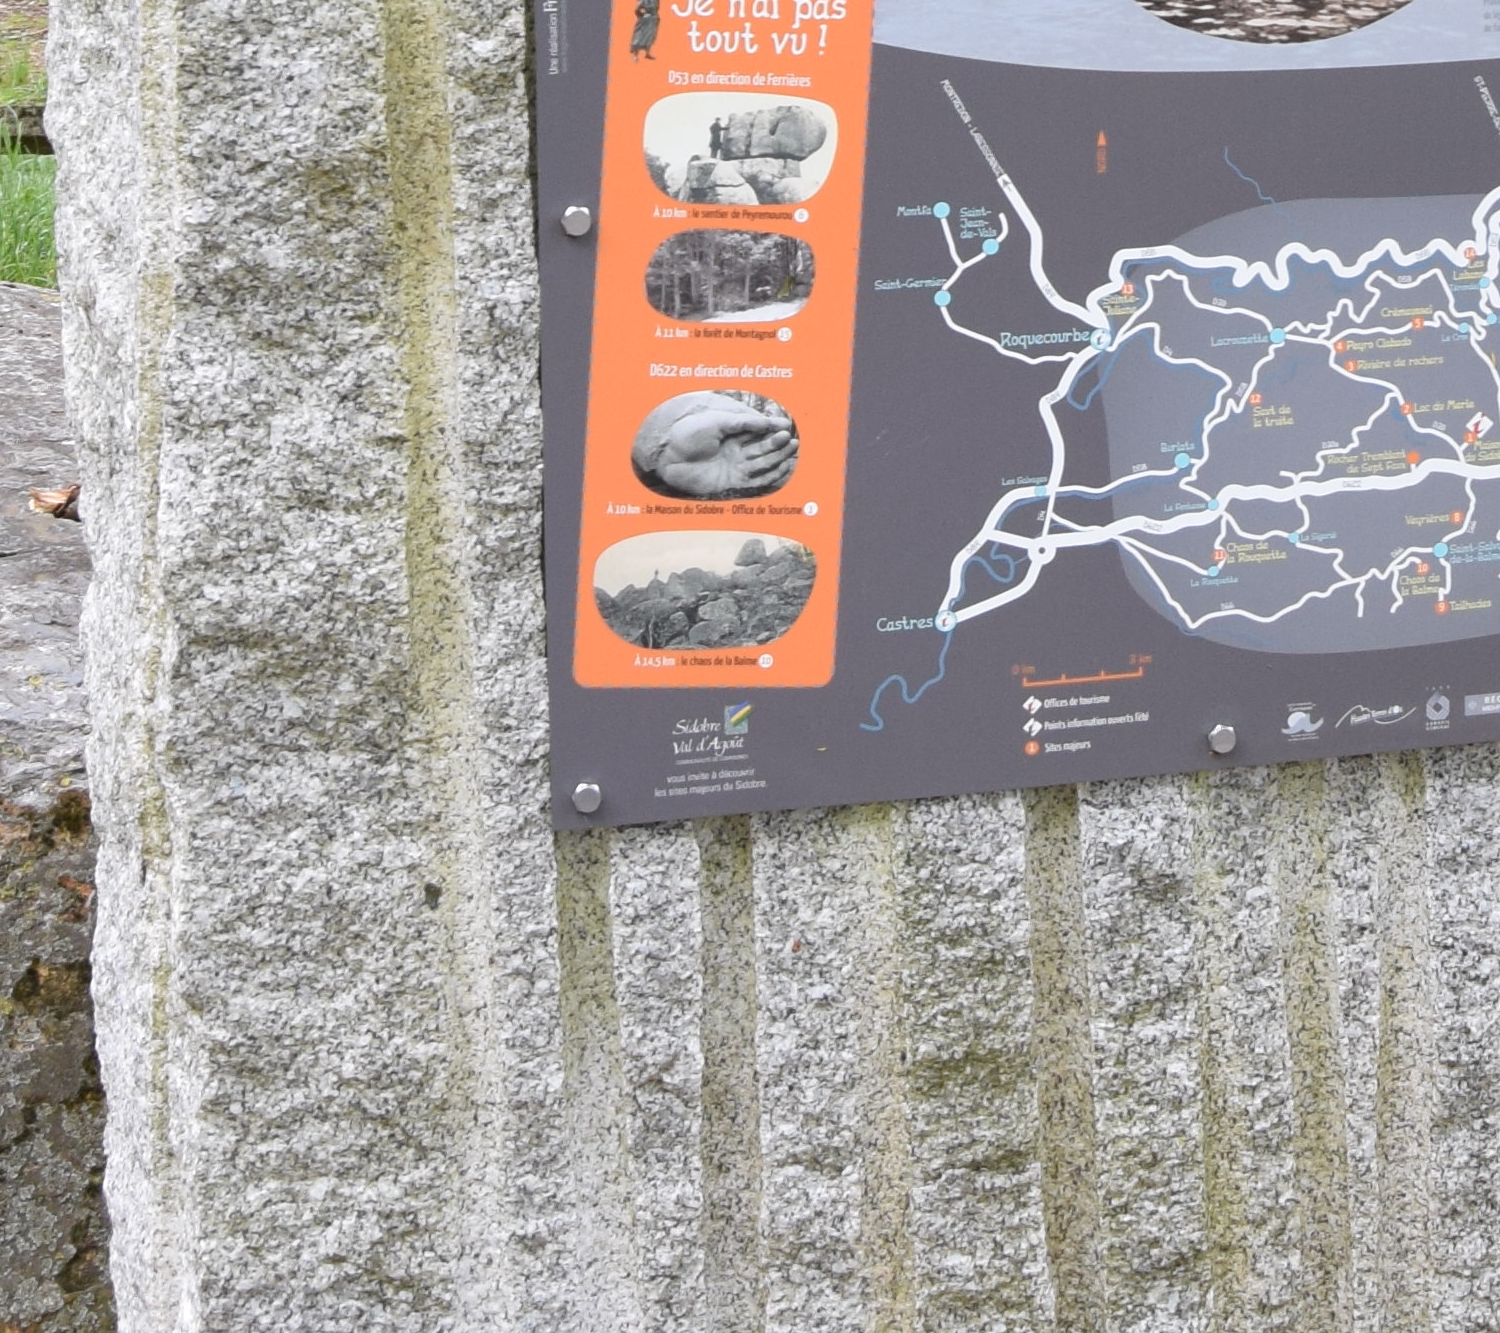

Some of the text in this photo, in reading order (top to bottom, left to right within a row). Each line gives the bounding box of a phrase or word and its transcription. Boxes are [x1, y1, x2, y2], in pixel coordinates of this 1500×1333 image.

[687, 21, 829, 56] tout vu !
[548, 58, 559, 75] Une
[668, 70, 811, 87] D53 en direction de Ferrières
[701, 209, 728, 218] sentier
[730, 209, 740, 219] de
[1000, 328, 1091, 348] Roquecourbe
[650, 363, 793, 379] D622 en direction de Castres
[1395, 358, 1407, 368] de
[1413, 403, 1429, 413] Lac
[876, 617, 934, 632] Castres
[1070, 697, 1078, 706] de
[672, 717, 722, 735] Sidobre
[672, 739, 694, 755] Val
